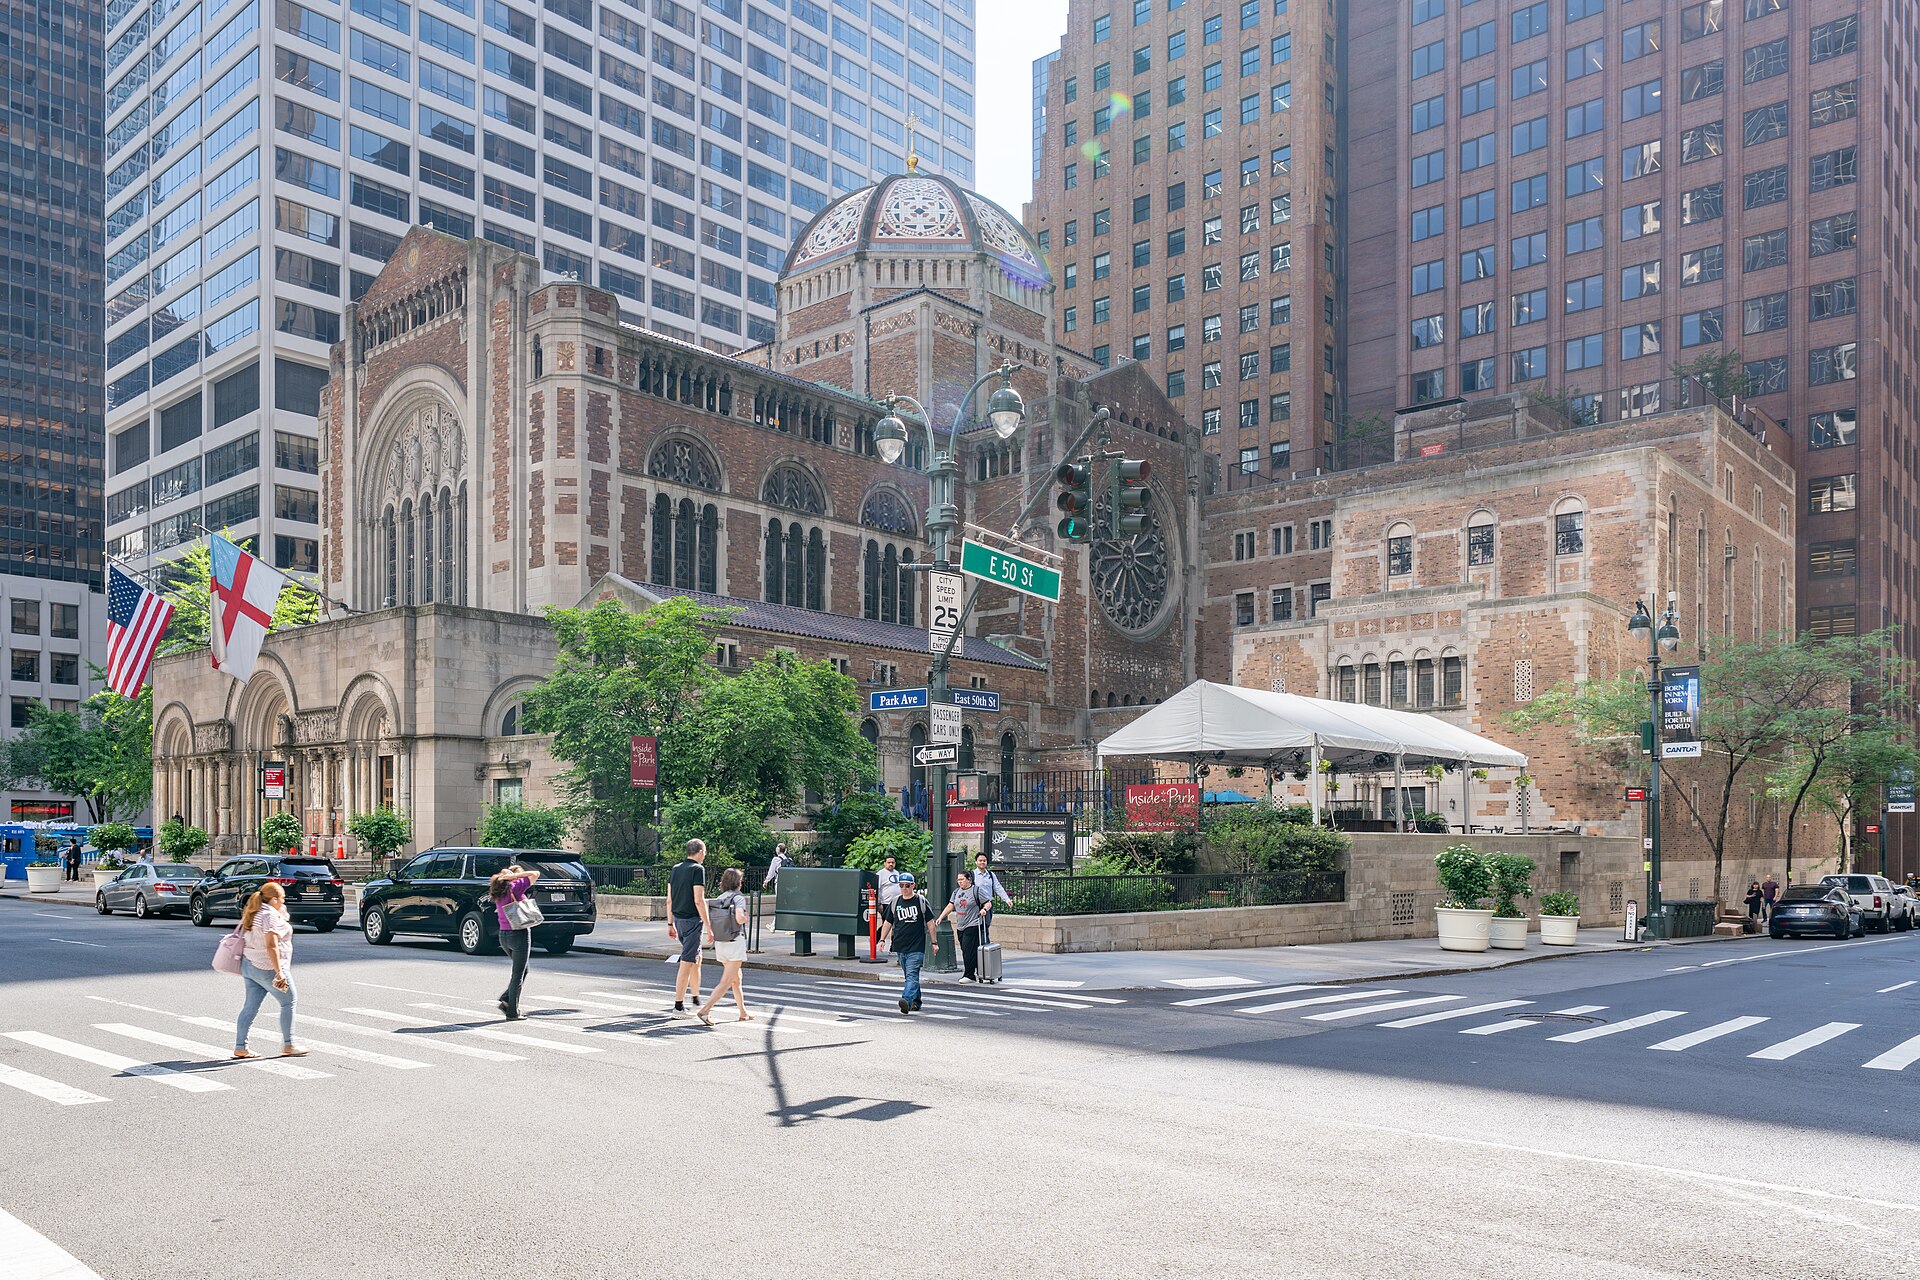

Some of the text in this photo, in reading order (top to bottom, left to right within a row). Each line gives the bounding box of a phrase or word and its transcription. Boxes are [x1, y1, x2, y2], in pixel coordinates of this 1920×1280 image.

[989, 555, 1034, 588] E 50 St
[938, 576, 953, 585] CITY
[936, 585, 956, 595] SPEED
[938, 595, 954, 604] LIMIT
[934, 605, 959, 630] 25
[932, 642, 960, 652] ENFOED
[937, 636, 951, 644] PHO
[879, 693, 918, 707] Park Ave
[954, 692, 997, 708] East 50th St
[933, 708, 960, 722] PASSENGER
[933, 723, 960, 738] CARS ONLY
[631, 740, 653, 754] Inside
[638, 752, 655, 767] Park
[920, 749, 952, 760] ONE WAY
[1128, 787, 1196, 808] Inside Park
